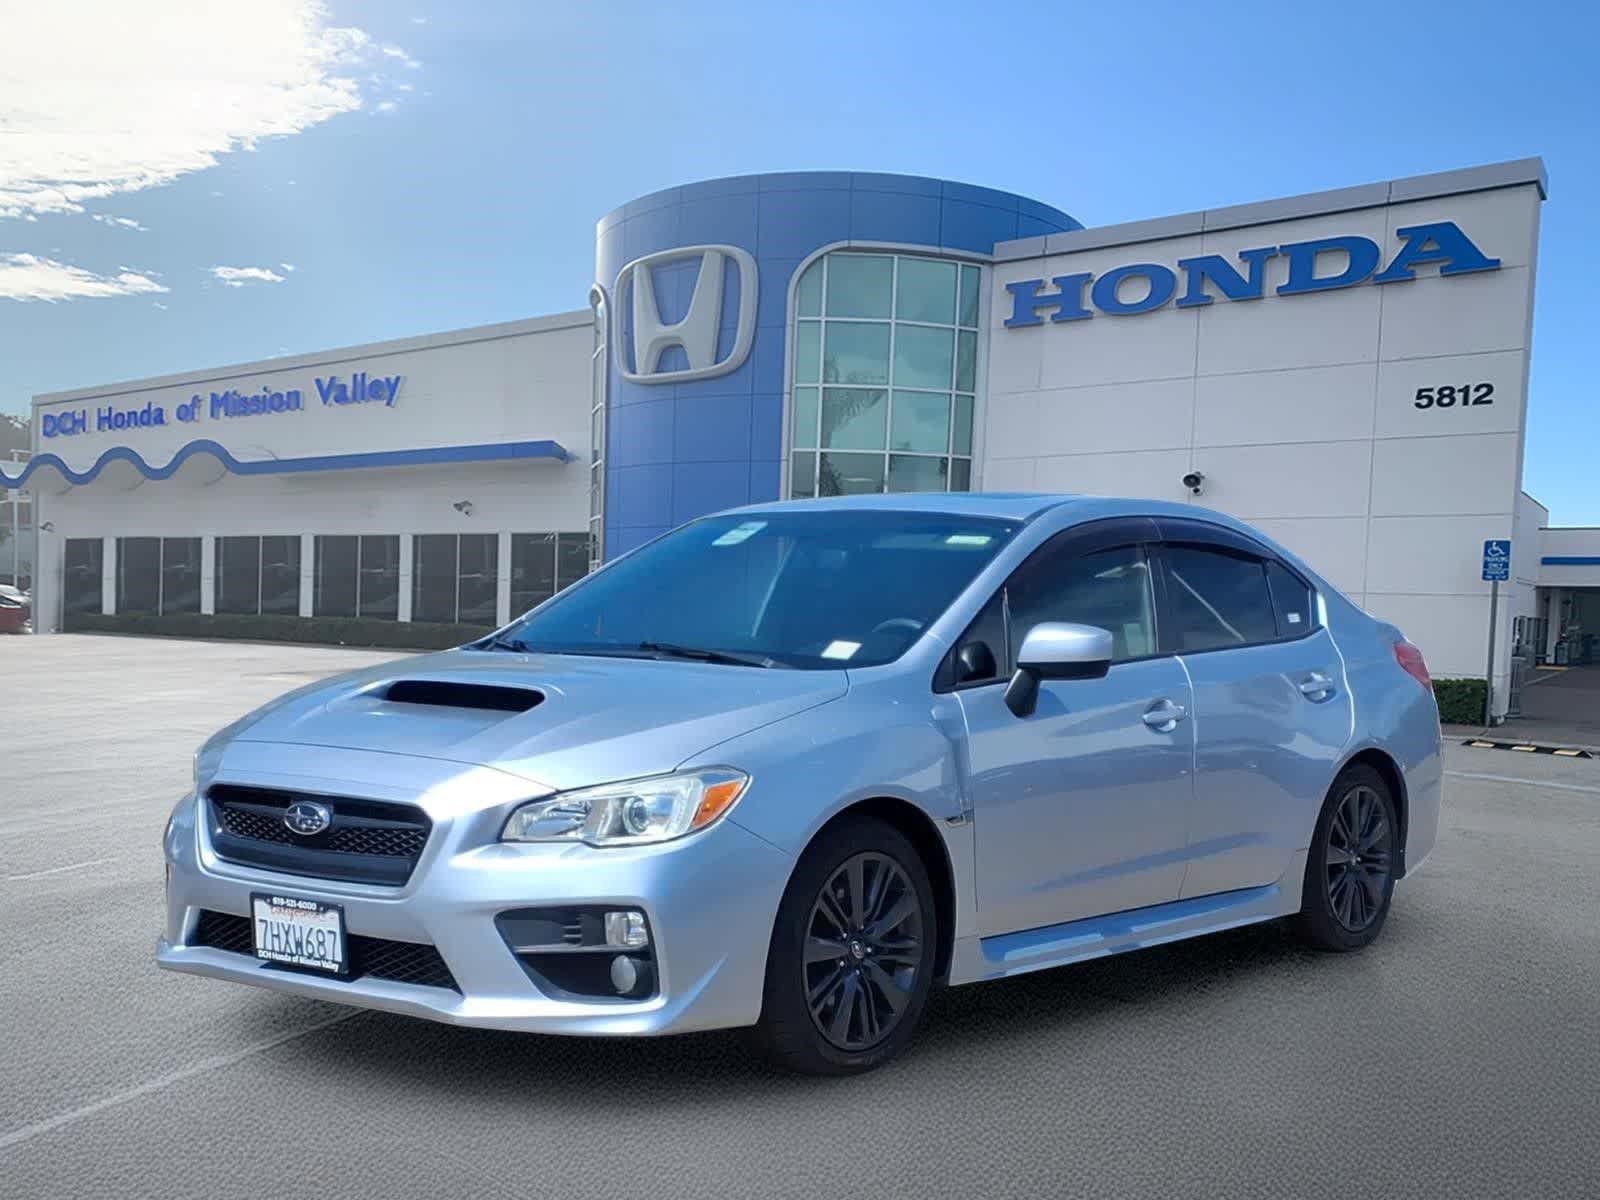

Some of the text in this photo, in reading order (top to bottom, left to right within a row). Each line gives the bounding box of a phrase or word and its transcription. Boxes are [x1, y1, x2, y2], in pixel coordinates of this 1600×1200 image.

[1004, 221, 1502, 328] HONDA
[42, 372, 401, 438] DCH Honda of Mission Valley
[1414, 383, 1494, 409] 5812
[258, 919, 337, 960] 7HXW687
